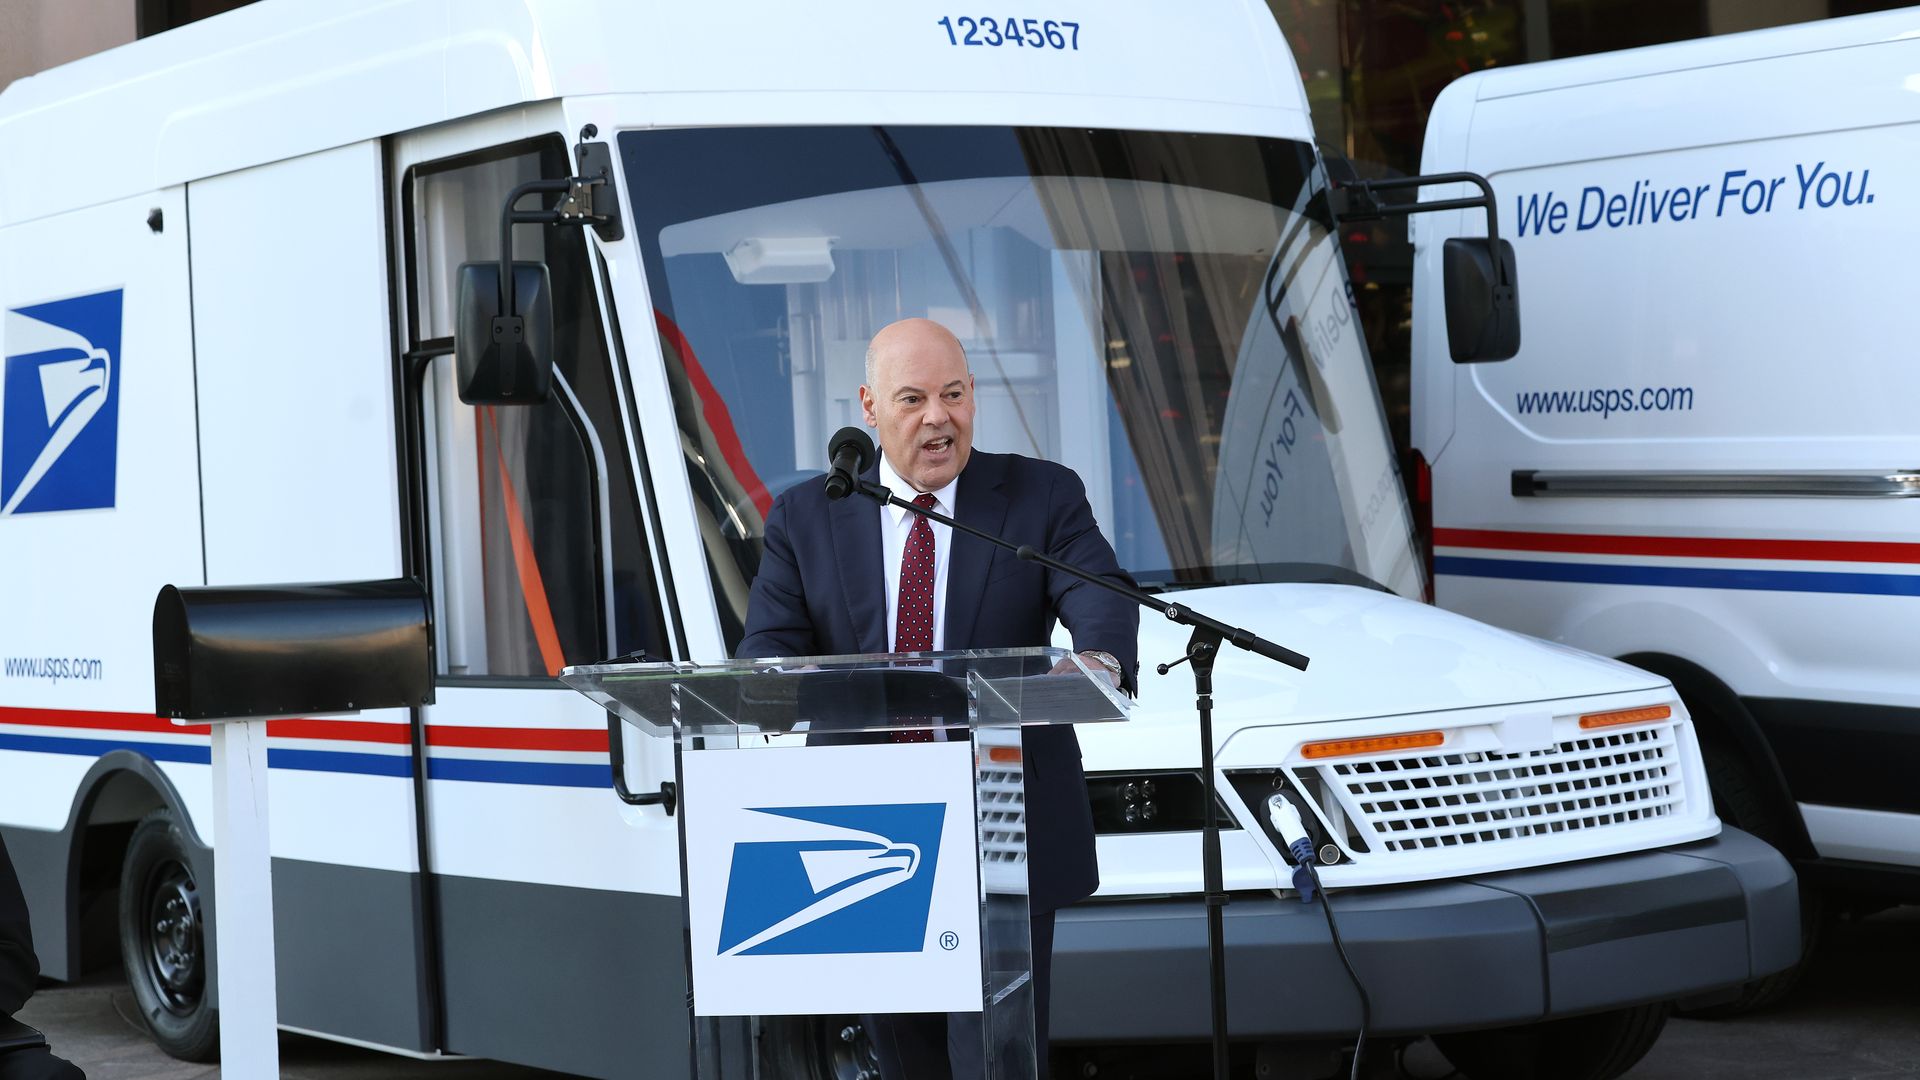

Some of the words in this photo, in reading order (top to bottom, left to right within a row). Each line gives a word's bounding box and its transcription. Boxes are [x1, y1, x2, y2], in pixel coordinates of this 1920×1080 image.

[937, 16, 1080, 51] 1234567
[1517, 191, 1568, 237] We
[1576, 179, 1710, 231] Deliver
[1716, 169, 1786, 217] For
[1796, 161, 1875, 210] You.
[1517, 386, 1693, 419] www.usps.com
[4, 657, 102, 685] www.usps.com
